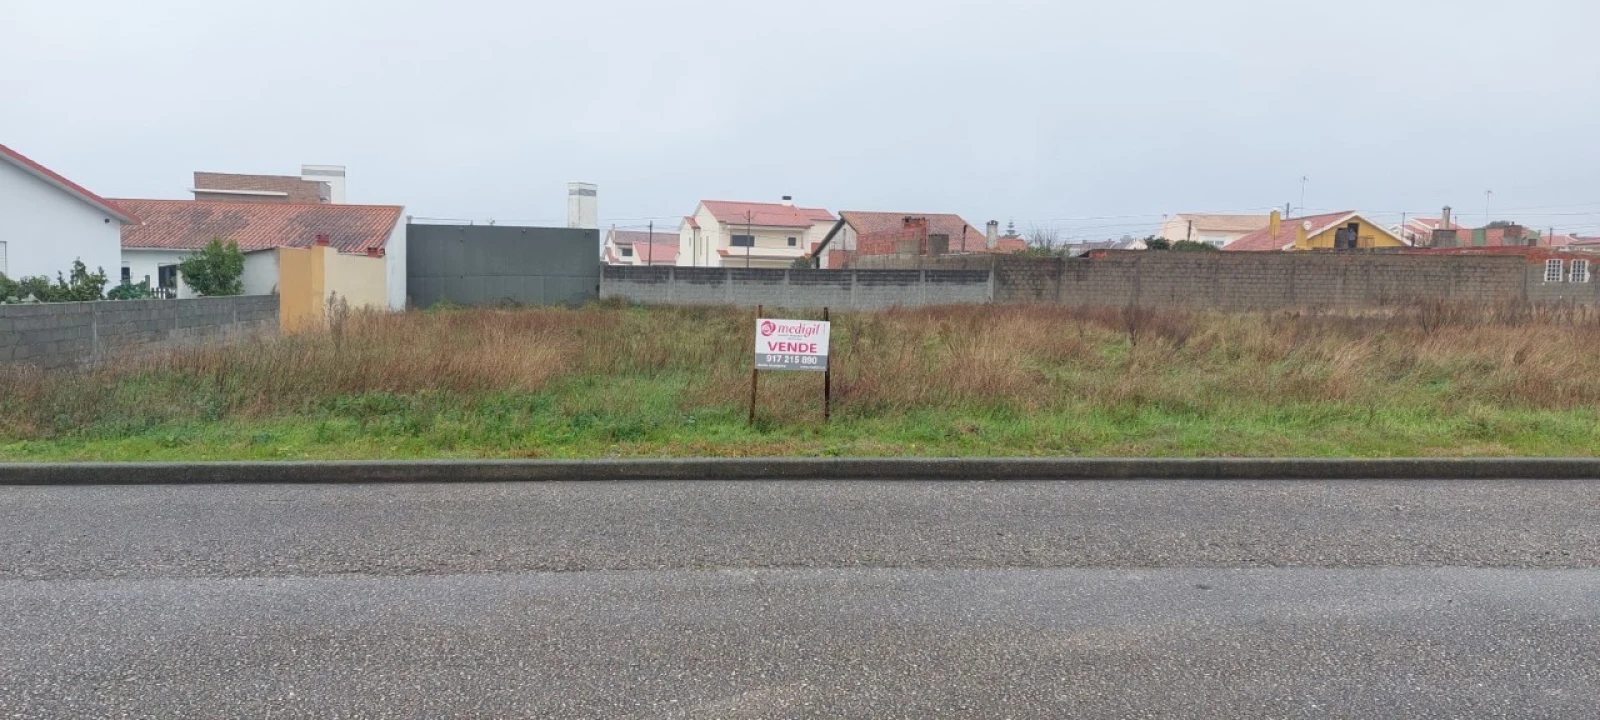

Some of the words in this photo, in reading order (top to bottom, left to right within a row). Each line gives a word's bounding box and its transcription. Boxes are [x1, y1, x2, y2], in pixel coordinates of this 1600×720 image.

[778, 323, 820, 337] medigil
[767, 341, 817, 353] VENDE
[766, 355, 781, 363] 917
[784, 355, 799, 364] 215
[801, 356, 817, 364] 890
